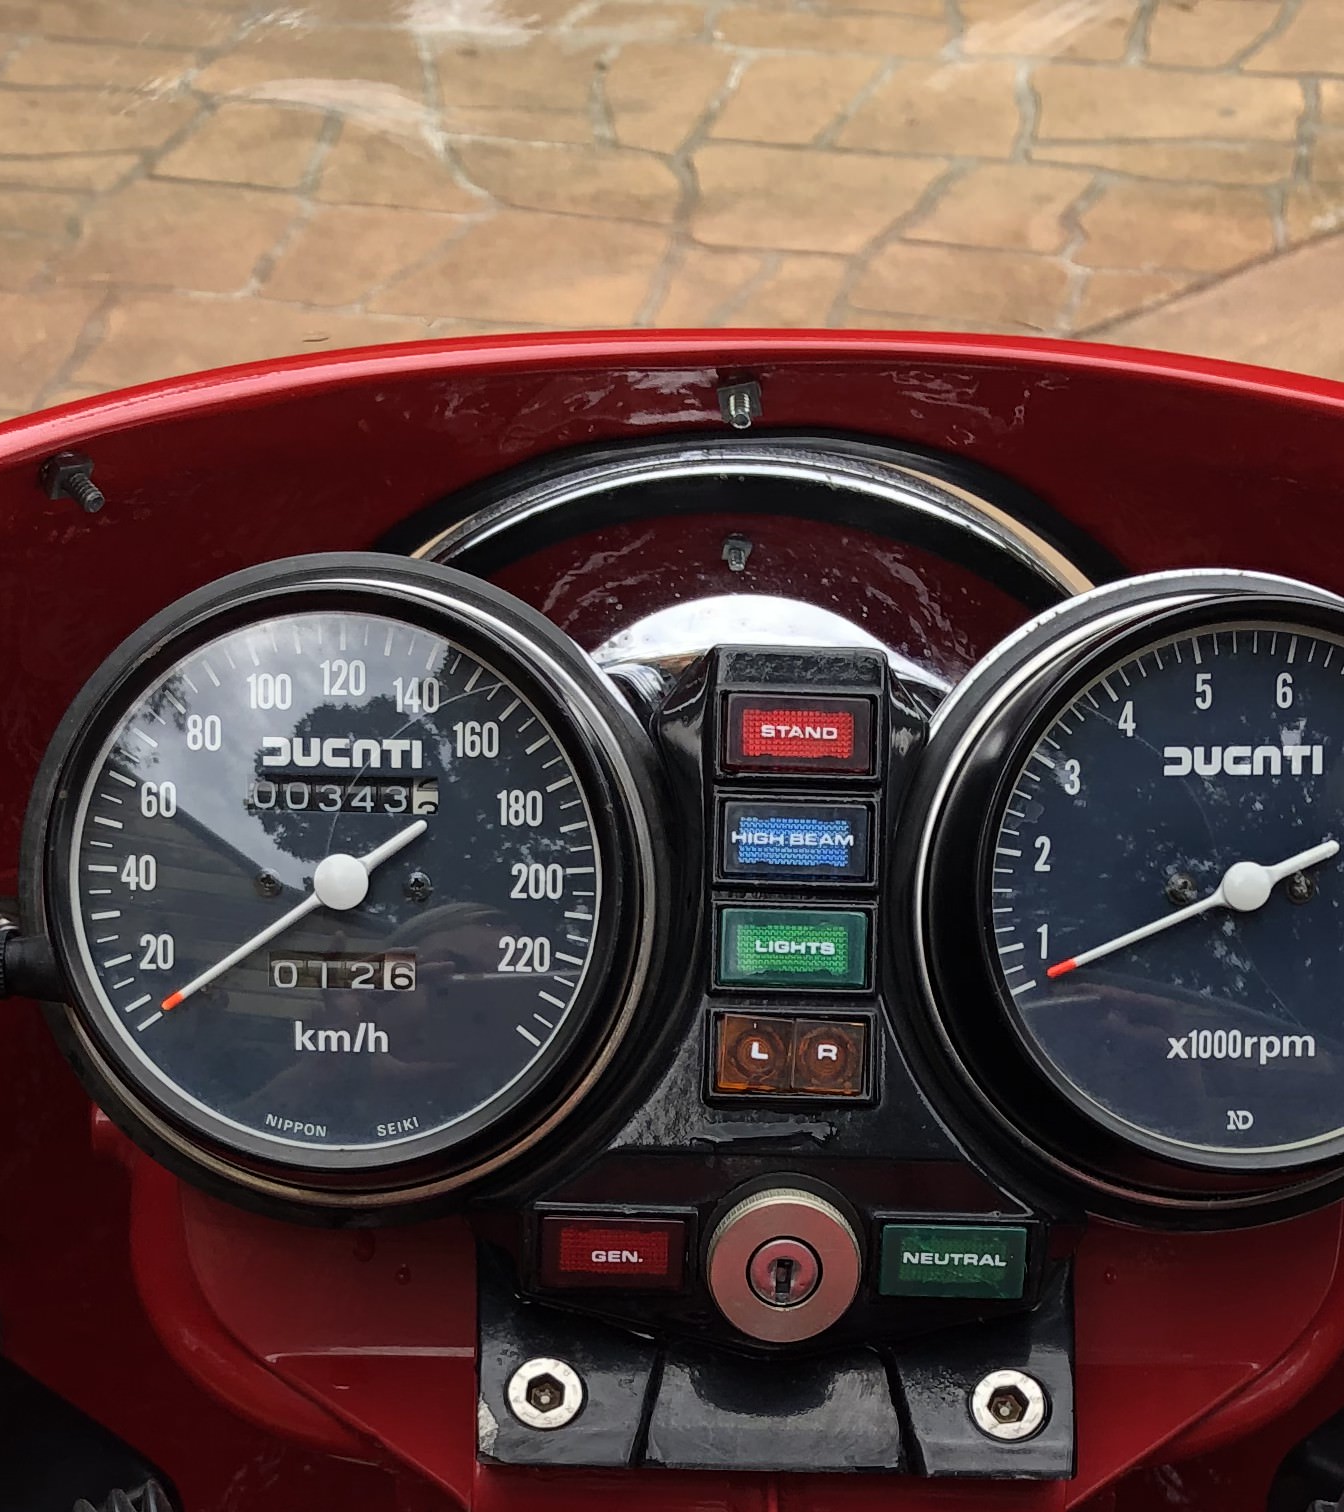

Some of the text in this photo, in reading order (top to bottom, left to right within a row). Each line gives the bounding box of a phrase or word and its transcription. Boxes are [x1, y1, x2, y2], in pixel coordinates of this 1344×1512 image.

[246, 673, 292, 710] 100
[319, 659, 366, 696] 120
[392, 676, 440, 714] 140
[1195, 673, 1213, 710] 5
[1276, 672, 1293, 709] 6
[186, 715, 222, 751] 80
[760, 722, 838, 740] STAND
[1118, 701, 1136, 737] 4
[262, 736, 423, 769] DUCATI
[453, 721, 499, 758] 160
[1063, 758, 1081, 796] 3
[1163, 746, 1323, 776] DUCATI
[140, 782, 176, 818] 60
[497, 790, 543, 826] 180
[731, 830, 854, 847] HIGH BEAM
[1034, 835, 1051, 872] 2
[120, 854, 157, 891] 40
[510, 863, 563, 900] 200
[139, 933, 175, 970] 20
[497, 936, 551, 972] 220
[755, 939, 836, 956] LIGHTS
[1036, 923, 1048, 960] 1
[273, 958, 415, 991] 0126
[294, 1020, 389, 1053] km/h
[750, 1041, 769, 1060] L
[817, 1044, 838, 1061] R
[265, 1113, 420, 1138] NIPPON SEIKI
[591, 1250, 644, 1263] GEN.
[902, 1251, 1007, 1267] NEUTRAL
